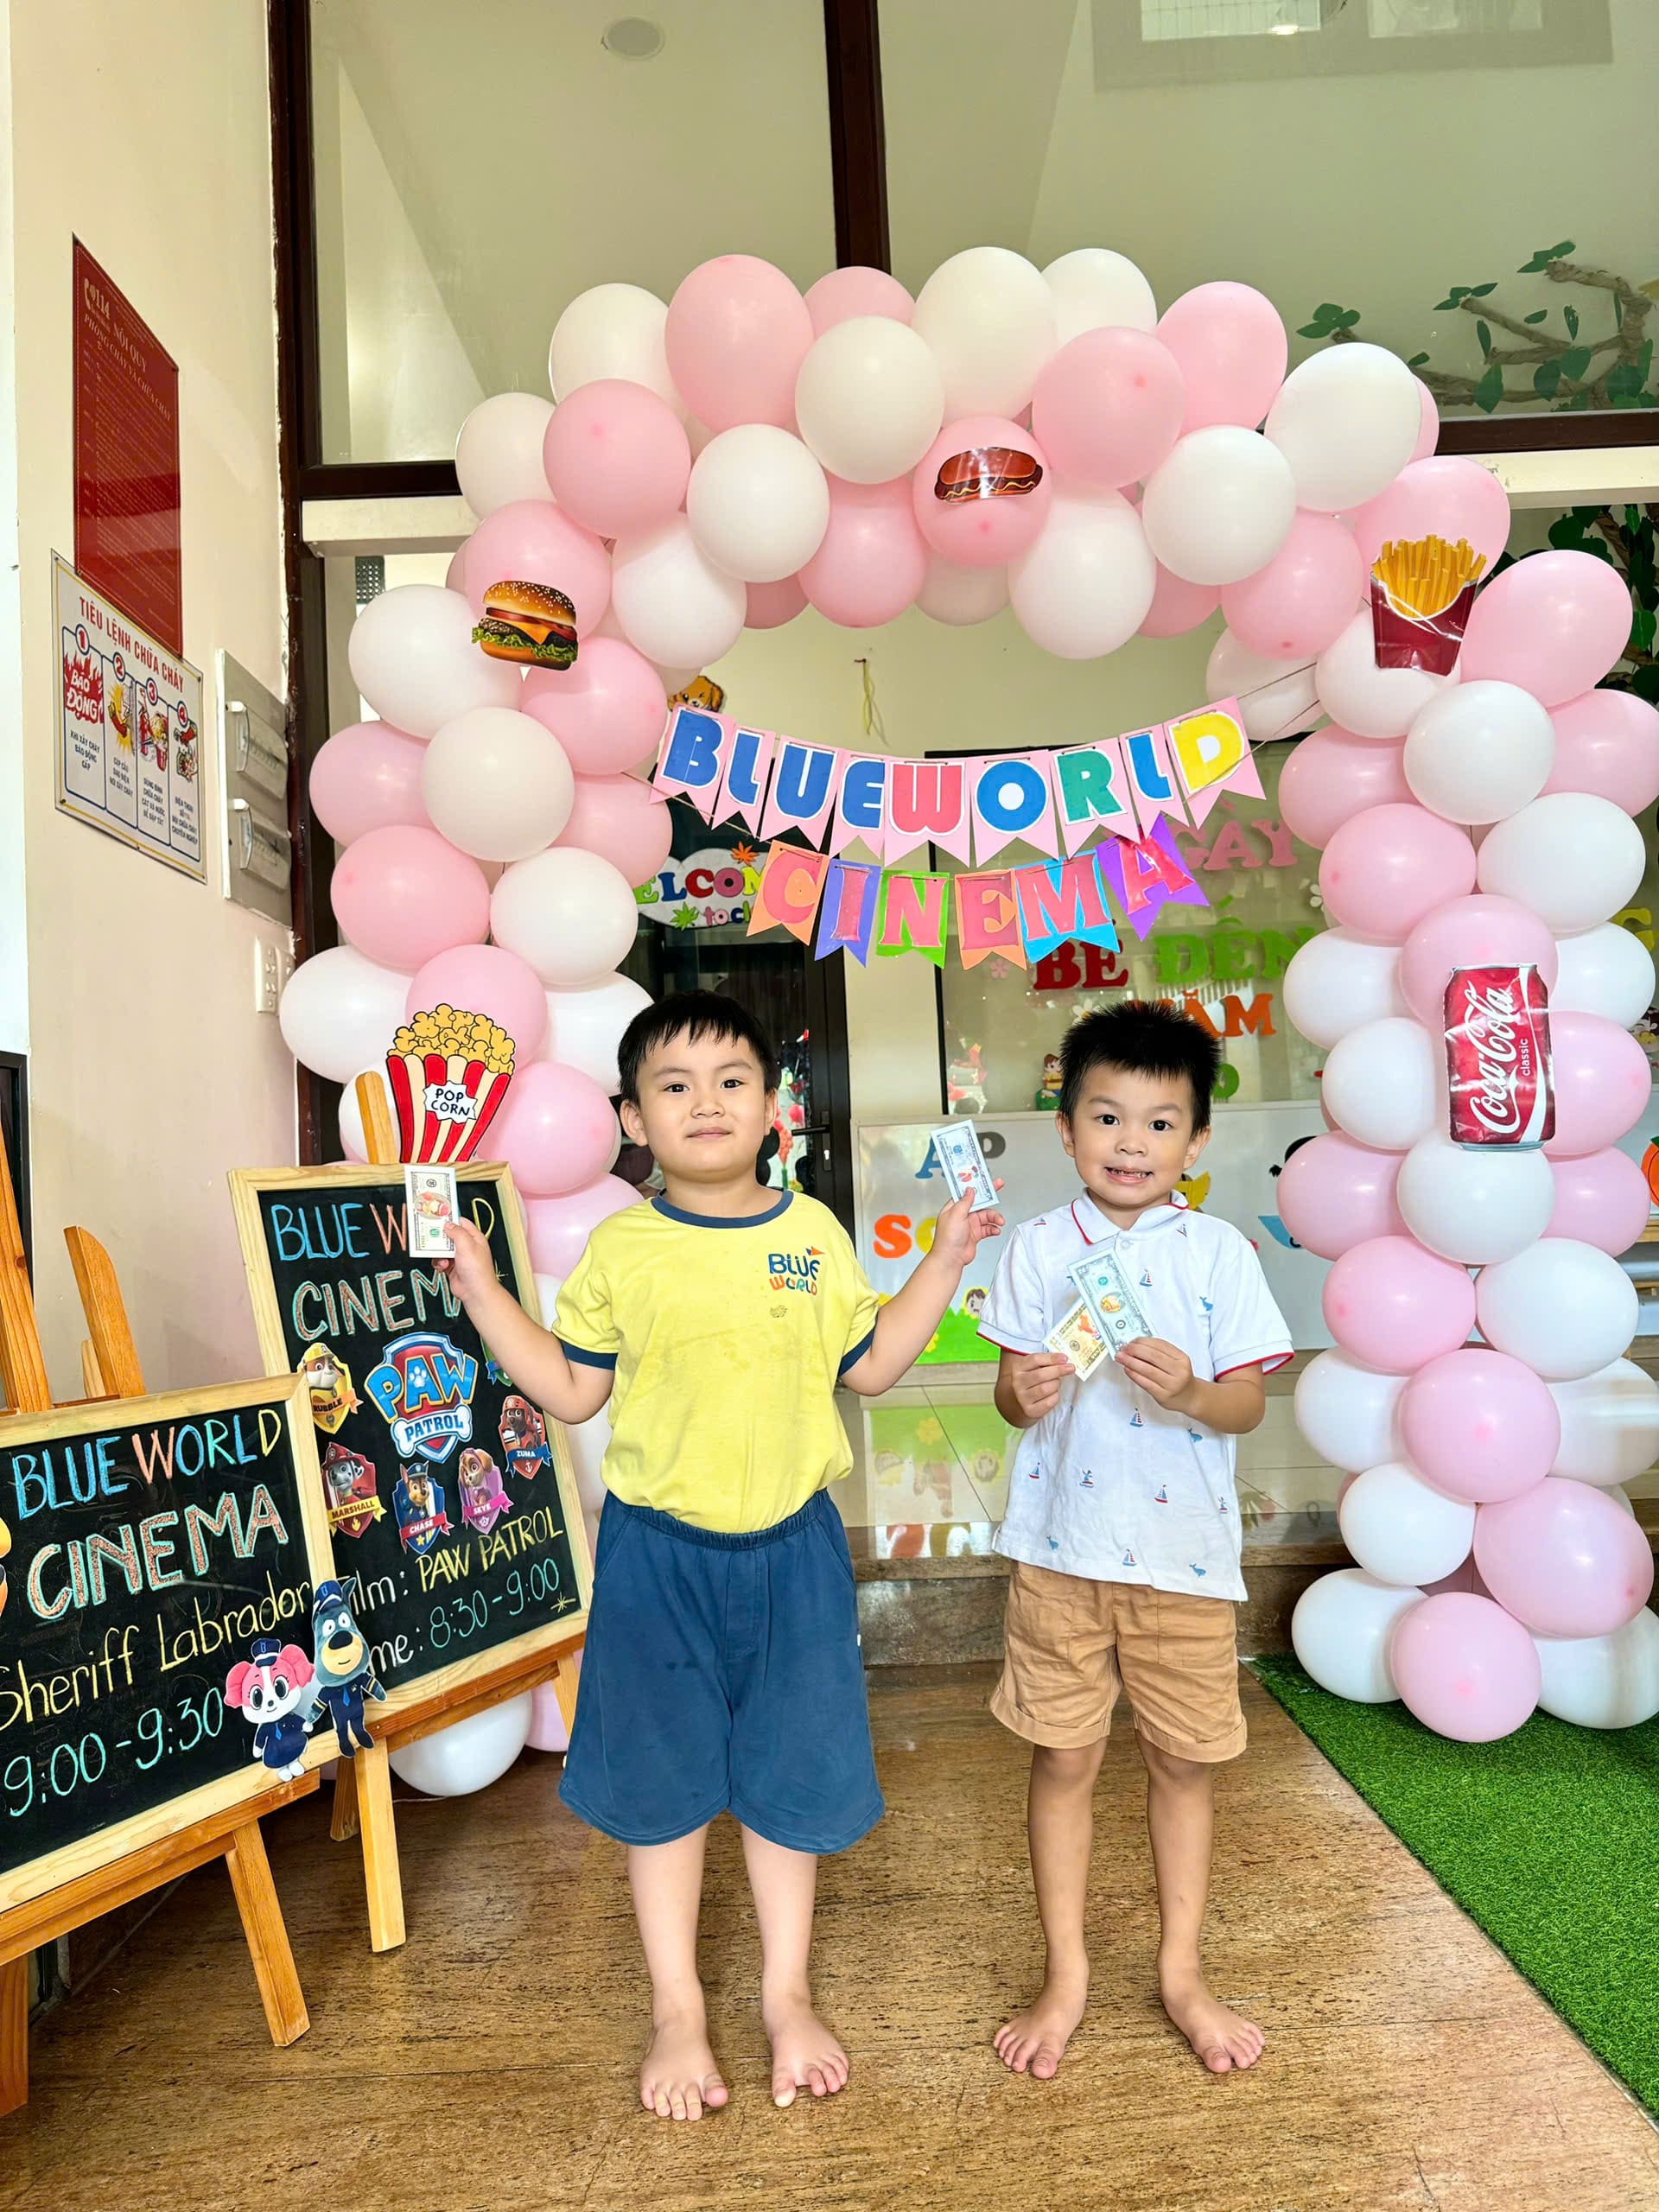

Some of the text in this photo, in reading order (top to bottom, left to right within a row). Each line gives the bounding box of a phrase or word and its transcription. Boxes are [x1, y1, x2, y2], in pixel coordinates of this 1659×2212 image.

[79, 629, 86, 651] 1
[79, 596, 184, 693] TIÊU LỆNH CHỮA CHÁY
[115, 656, 124, 677] 2
[67, 688, 98, 721] ĐỘNG
[149, 682, 156, 703] 3
[763, 827, 1194, 948] CINEMA
[1521, 1038, 1531, 1077] classic
[431, 1099, 471, 1116] CORN
[435, 1088, 464, 1103] POP
[270, 1202, 371, 1262] BLUE
[768, 1253, 821, 1281] BLUE
[769, 1274, 818, 1296] WORLD
[292, 1268, 461, 1341] CINEM
[365, 1352, 479, 1424] PAW
[404, 1414, 464, 1442] PATROL
[12, 1408, 283, 1521] BLUE WORLD
[516, 1449, 537, 1459] ZUMA
[331, 1500, 375, 1520] MARSHALL
[409, 1520, 435, 1535] CHASE
[27, 1484, 289, 1620] CINEMA
[415, 1543, 471, 1592] PAW
[477, 1506, 564, 1572] PATROL
[156, 1570, 311, 1673] Labrador
